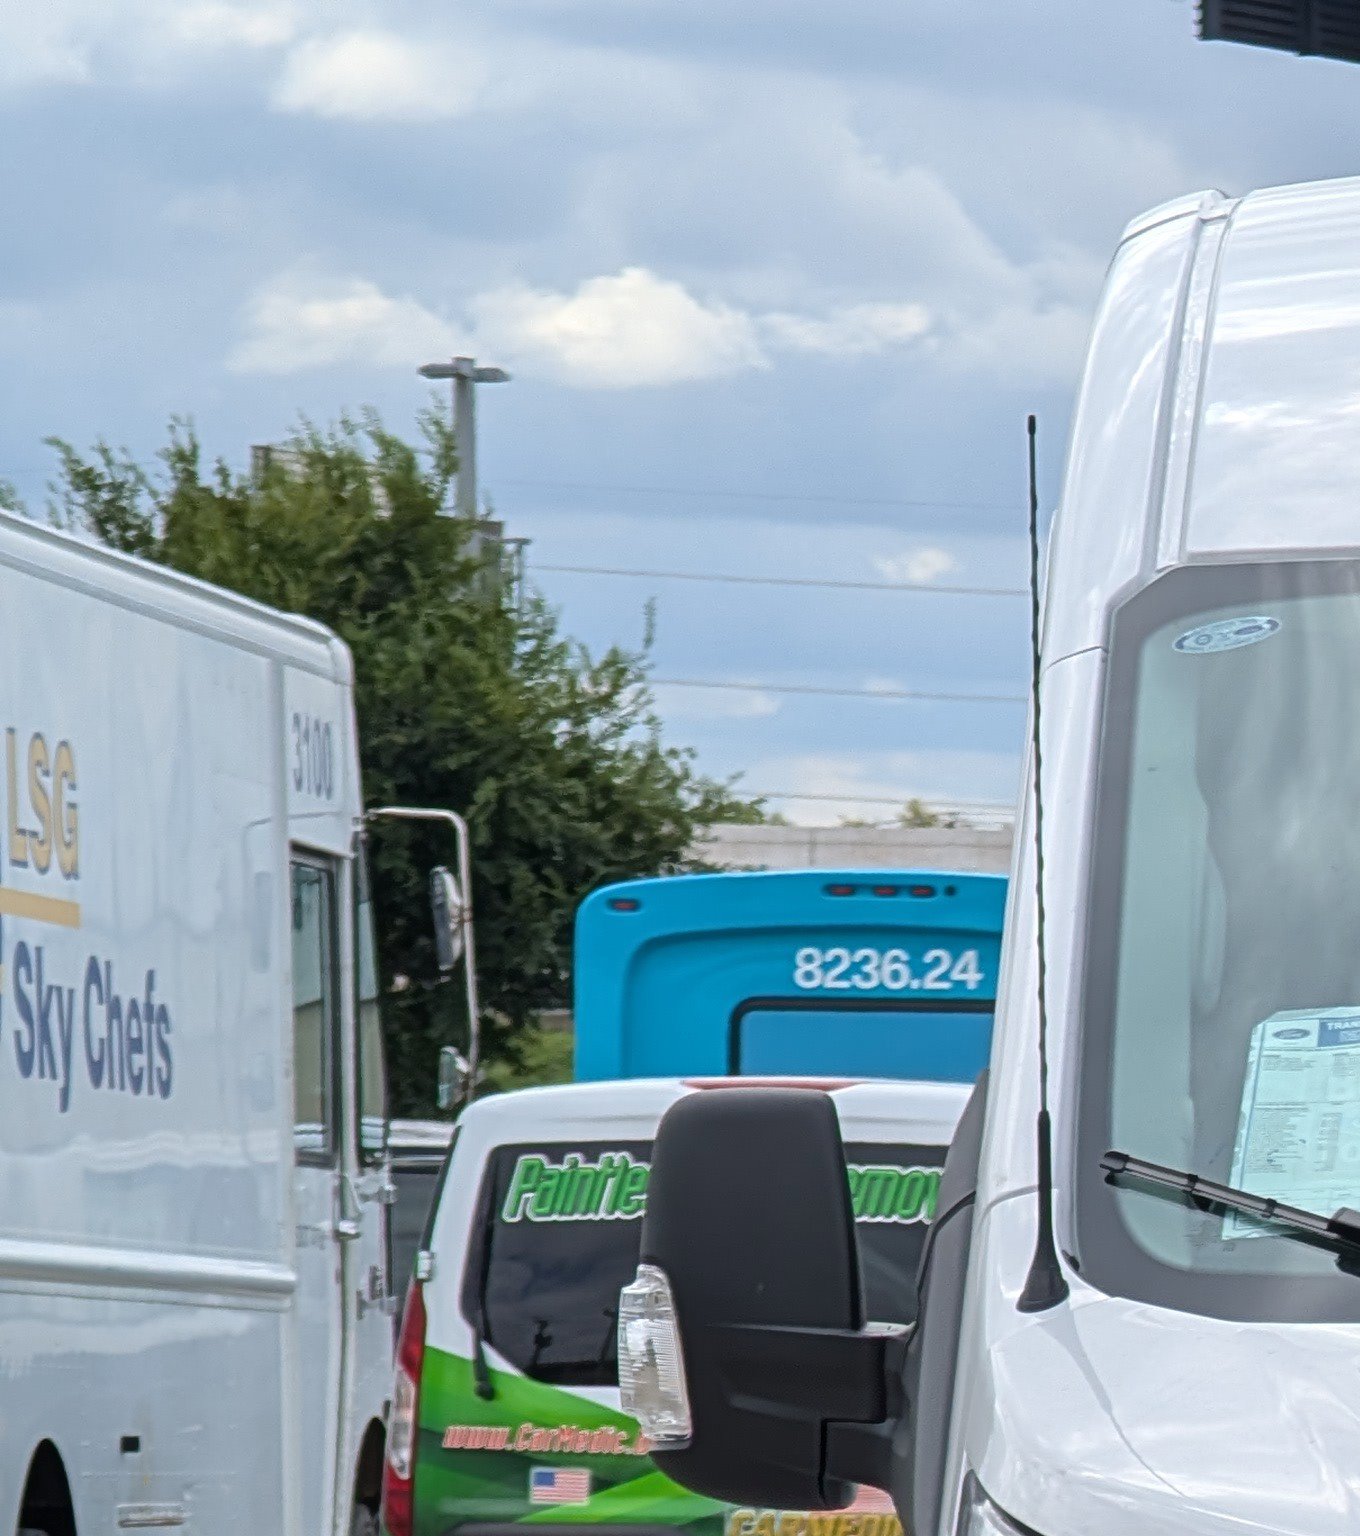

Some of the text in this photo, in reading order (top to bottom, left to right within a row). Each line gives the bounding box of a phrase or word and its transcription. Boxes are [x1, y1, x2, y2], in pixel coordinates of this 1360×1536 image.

[6, 727, 80, 880] LSG
[793, 947, 985, 990] 8236.24
[13, 941, 174, 1113] Sky Chefs
[502, 1152, 651, 1222] Paintle
